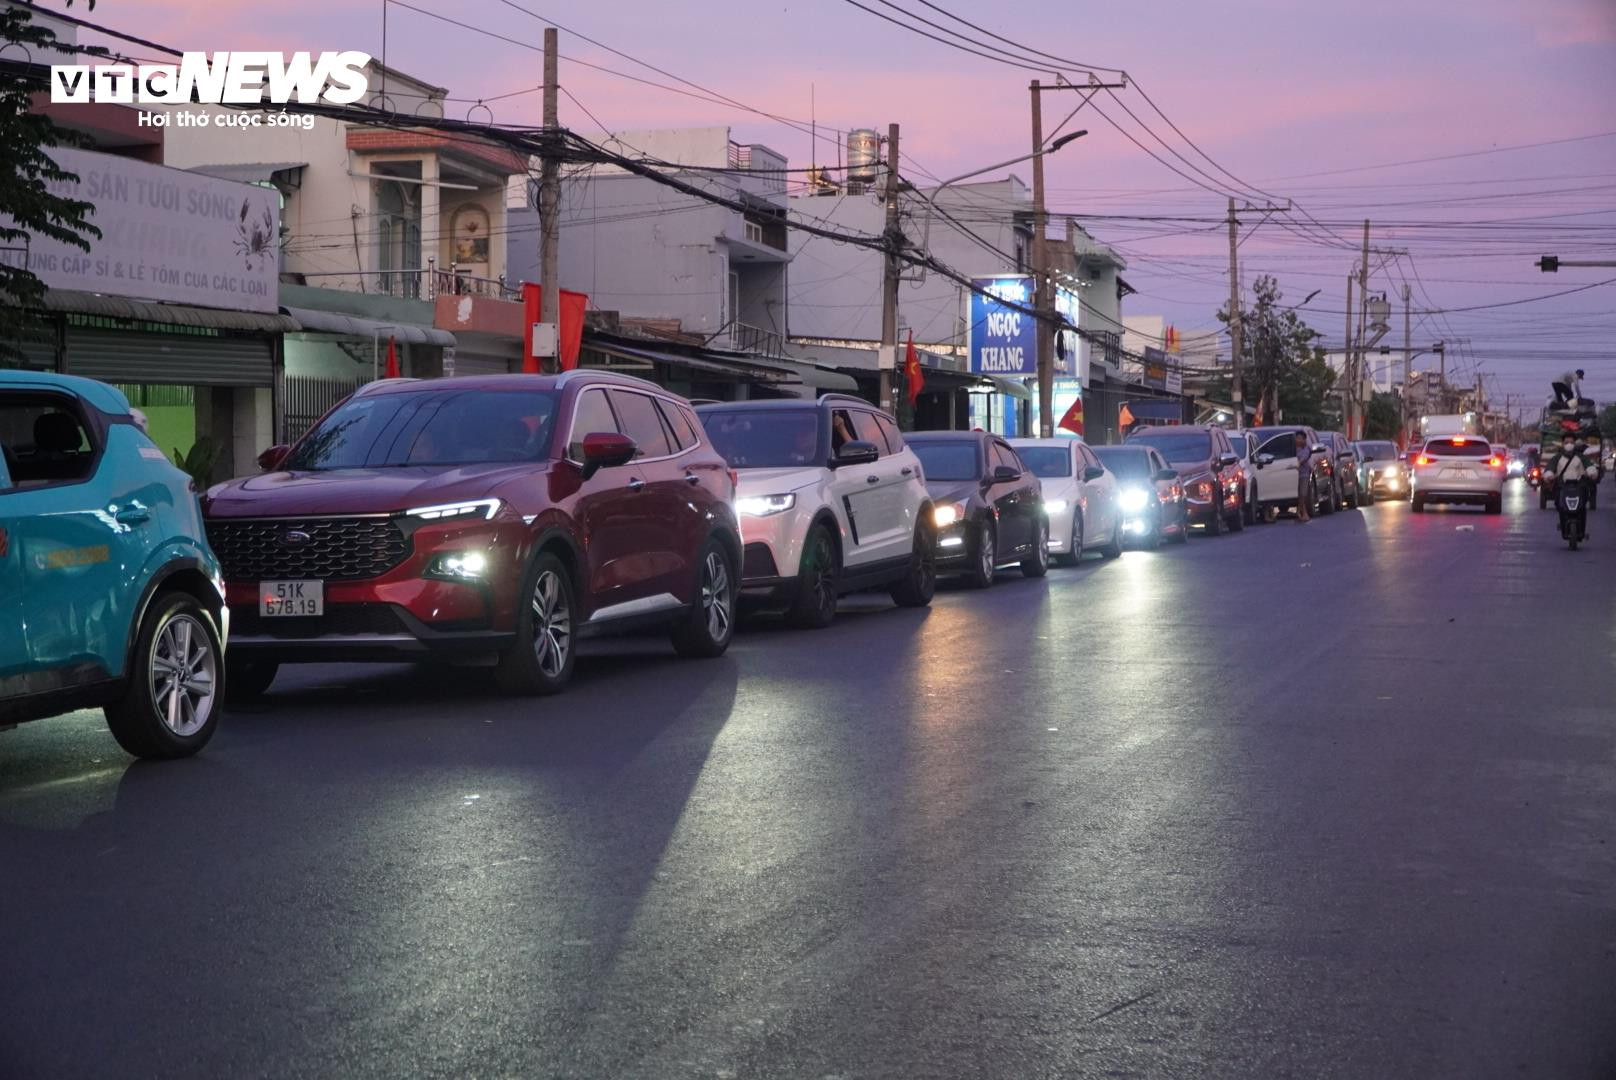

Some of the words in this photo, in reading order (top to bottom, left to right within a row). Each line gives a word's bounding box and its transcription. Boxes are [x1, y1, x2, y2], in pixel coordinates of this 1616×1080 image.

[87, 162, 128, 202] SẢN
[114, 263, 124, 278] &
[151, 264, 180, 286] TÔM
[183, 270, 209, 289] CUA
[212, 272, 238, 293] CÁC
[987, 312, 1021, 342] NGỌC
[980, 347, 1024, 371] KHANG
[277, 583, 304, 598] 51K
